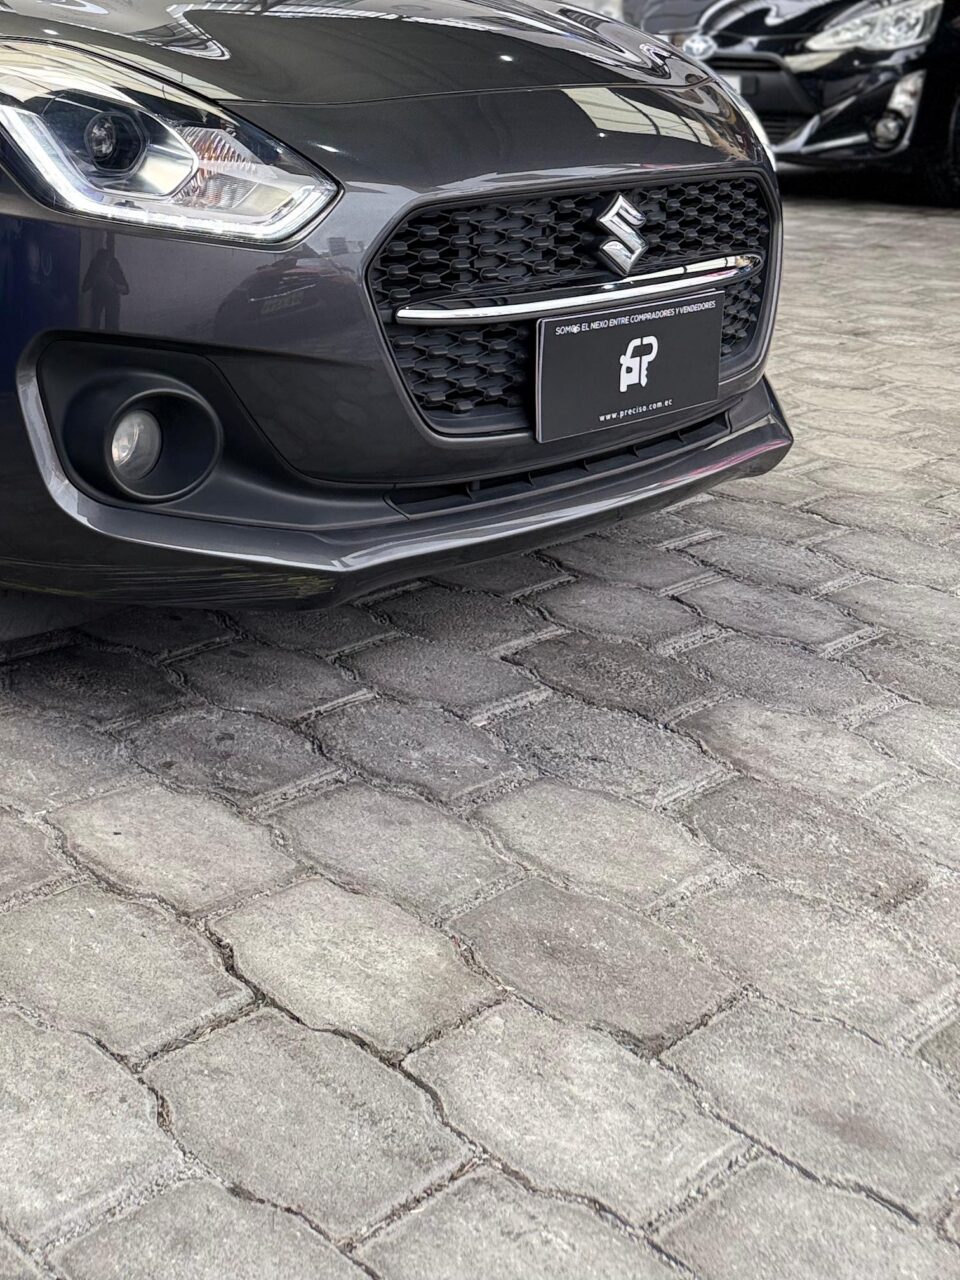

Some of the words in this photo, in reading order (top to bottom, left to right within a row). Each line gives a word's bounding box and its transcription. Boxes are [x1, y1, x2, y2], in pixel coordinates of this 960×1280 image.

[555, 324, 580, 336] SOMOS
[581, 322, 590, 332] EL
[590, 319, 609, 330] NEXO
[609, 316, 630, 327] ENTRE
[630, 308, 675, 323] COMPRADORES
[680, 300, 716, 314] VENDEDORES
[599, 398, 673, 422] www.preciso.com.ec
